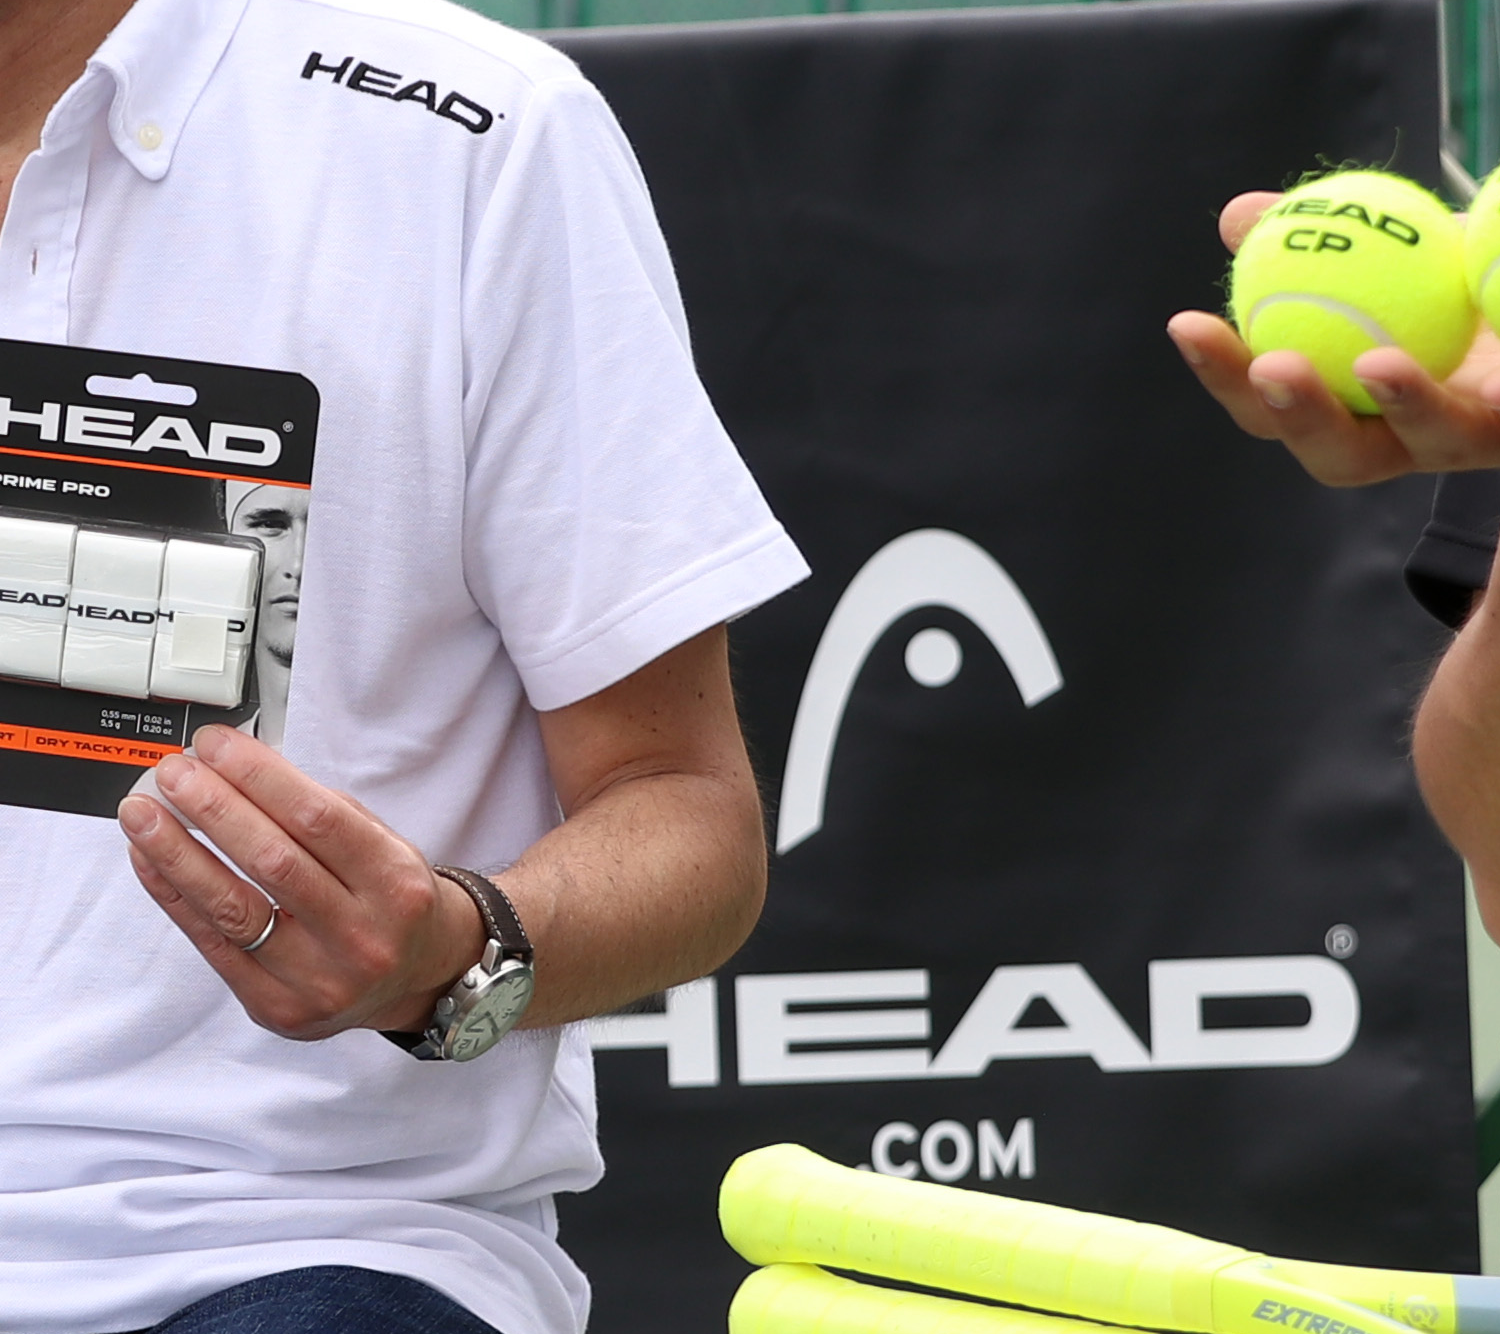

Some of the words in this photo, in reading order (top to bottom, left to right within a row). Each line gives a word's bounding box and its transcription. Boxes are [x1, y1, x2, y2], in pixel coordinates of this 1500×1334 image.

[300, 51, 494, 134] HEAD
[1283, 229, 1352, 253] CP
[62, 479, 111, 499] PRO
[157, 610, 246, 633] HD
[114, 721, 121, 730] g
[120, 712, 137, 721] mm
[163, 717, 172, 726] in
[35, 736, 70, 748] DRY
[73, 741, 124, 756] TACKY
[592, 955, 1362, 1087] HEAD
